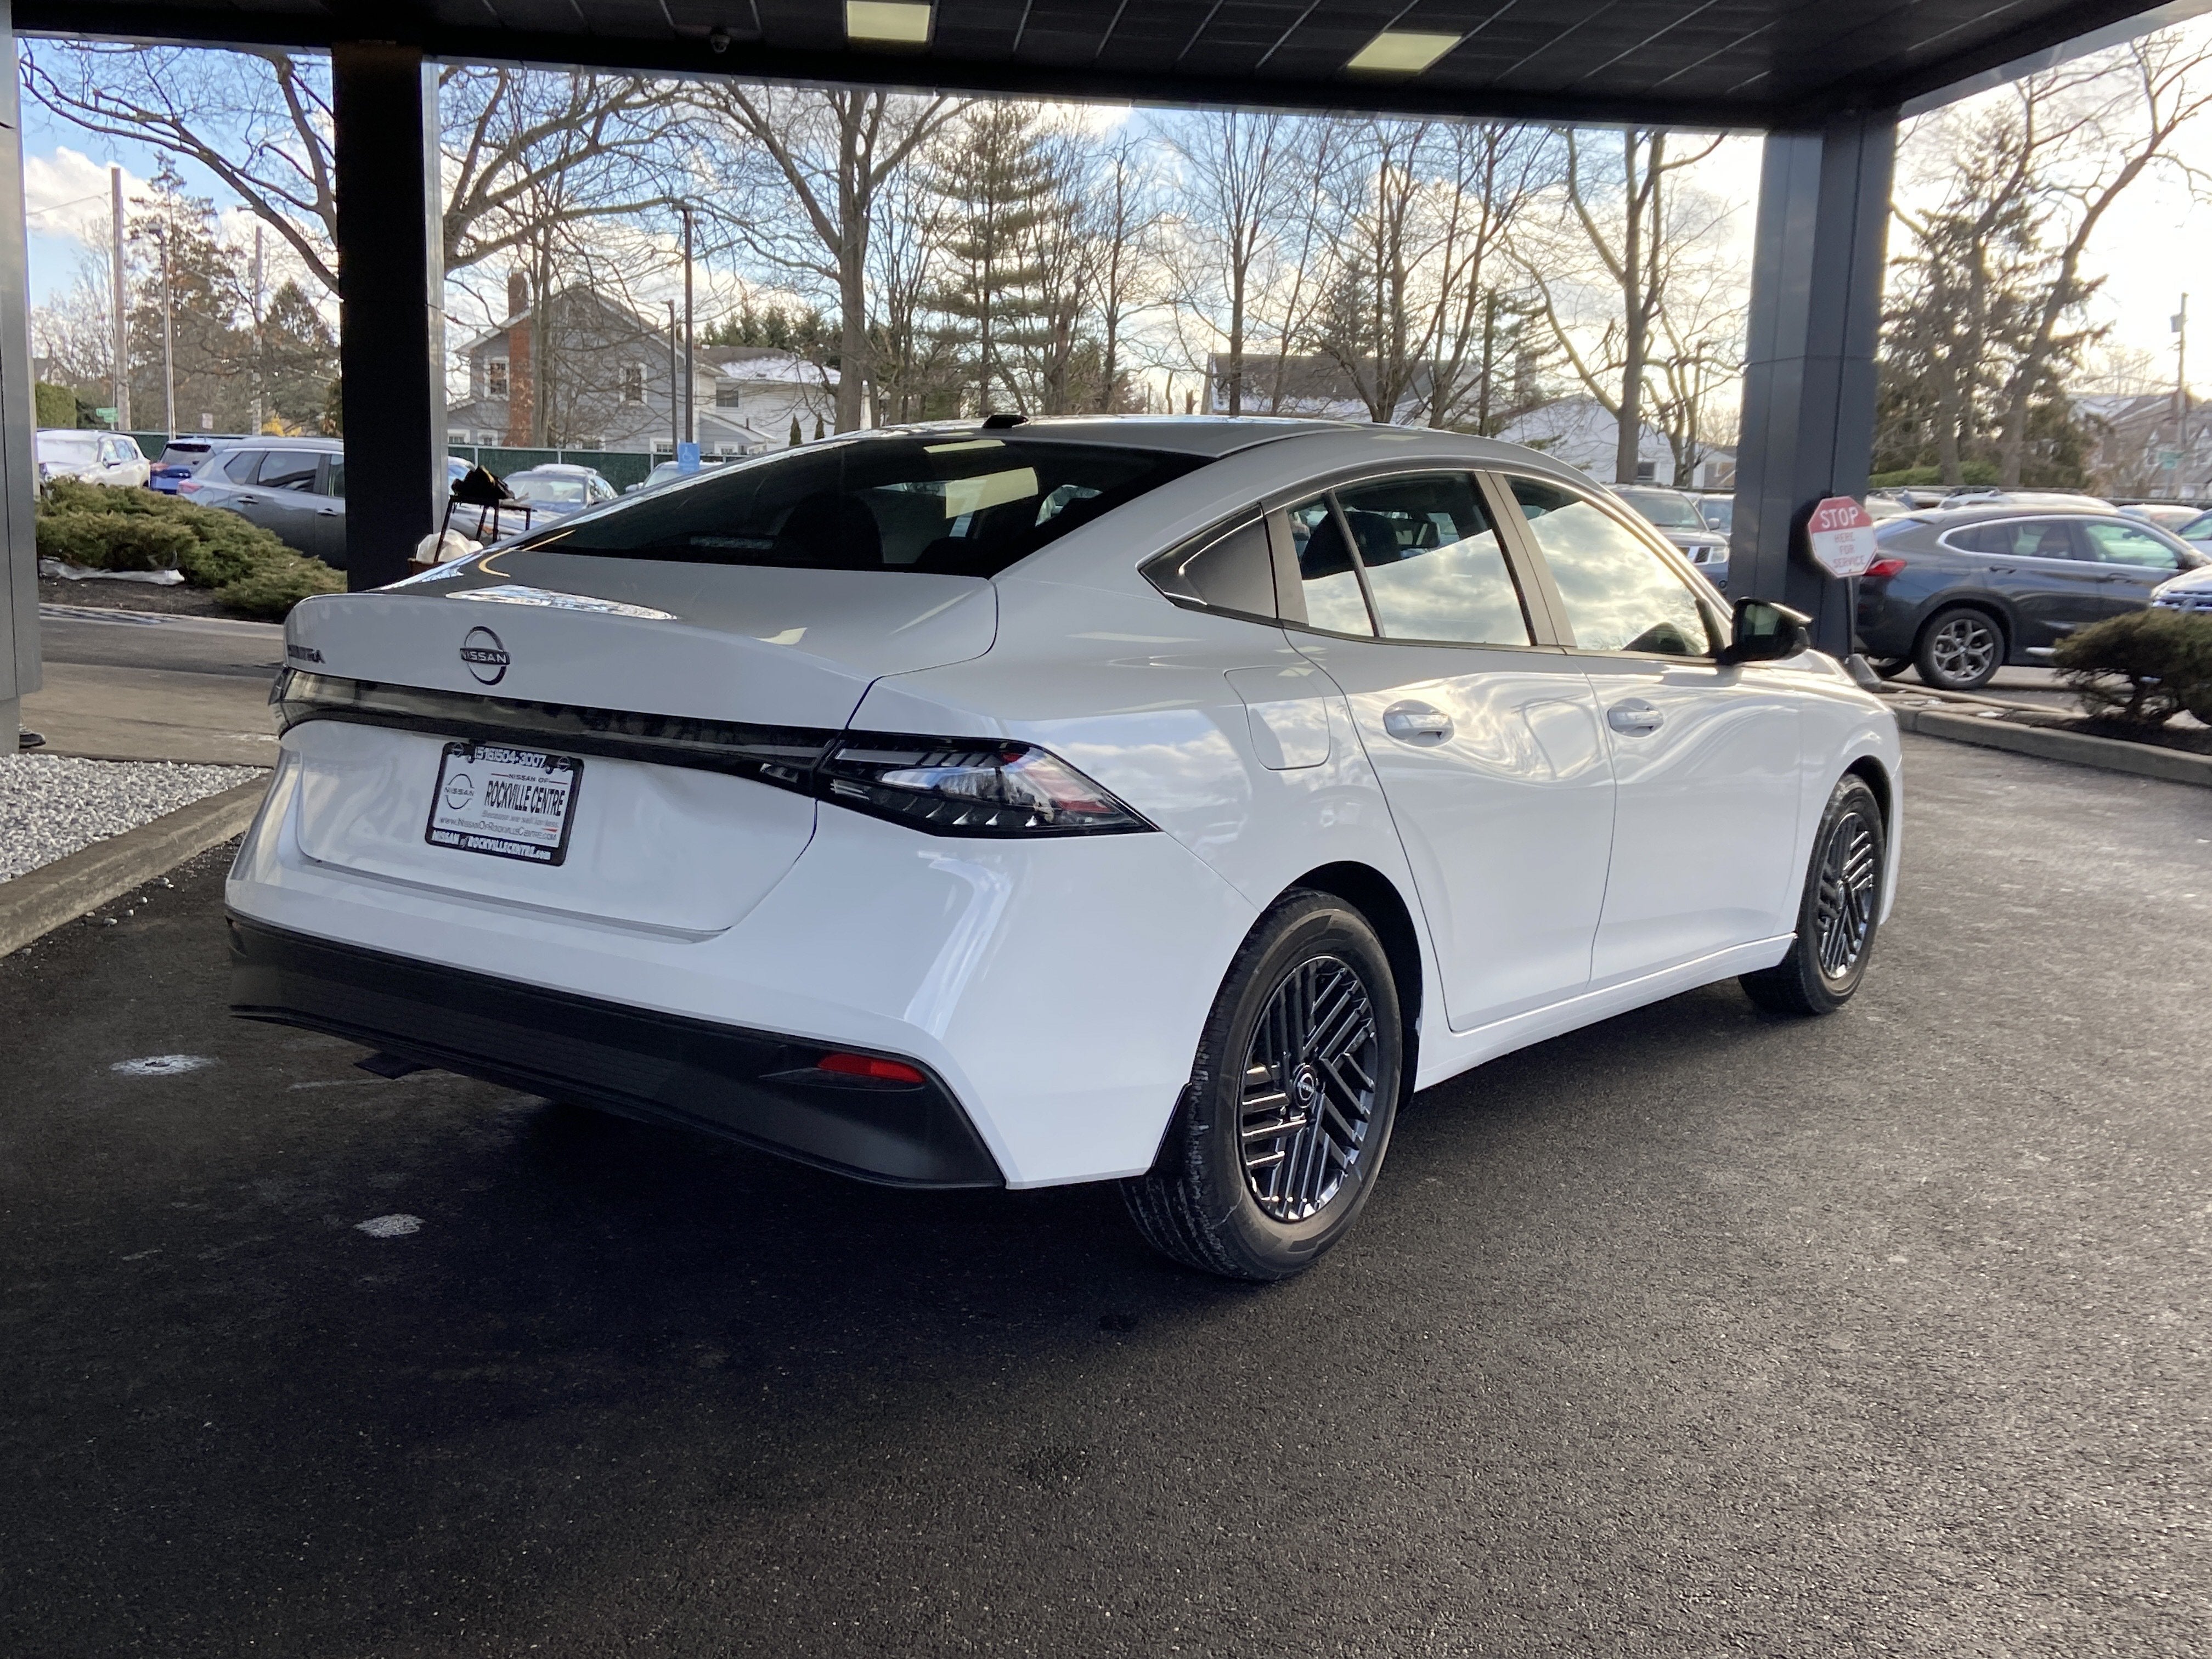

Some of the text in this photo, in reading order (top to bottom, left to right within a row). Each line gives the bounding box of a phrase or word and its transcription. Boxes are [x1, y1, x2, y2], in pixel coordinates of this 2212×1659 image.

[1820, 506, 1859, 529] STOP
[1834, 532, 1855, 543] HERE
[1839, 544, 1855, 555] FOR
[1833, 555, 1866, 568] SERVICE
[461, 650, 507, 663] NISSAN
[508, 774, 535, 782] NISSAN
[444, 786, 475, 796] NISSAN
[484, 781, 566, 816] ROCKVILLE CENTRE
